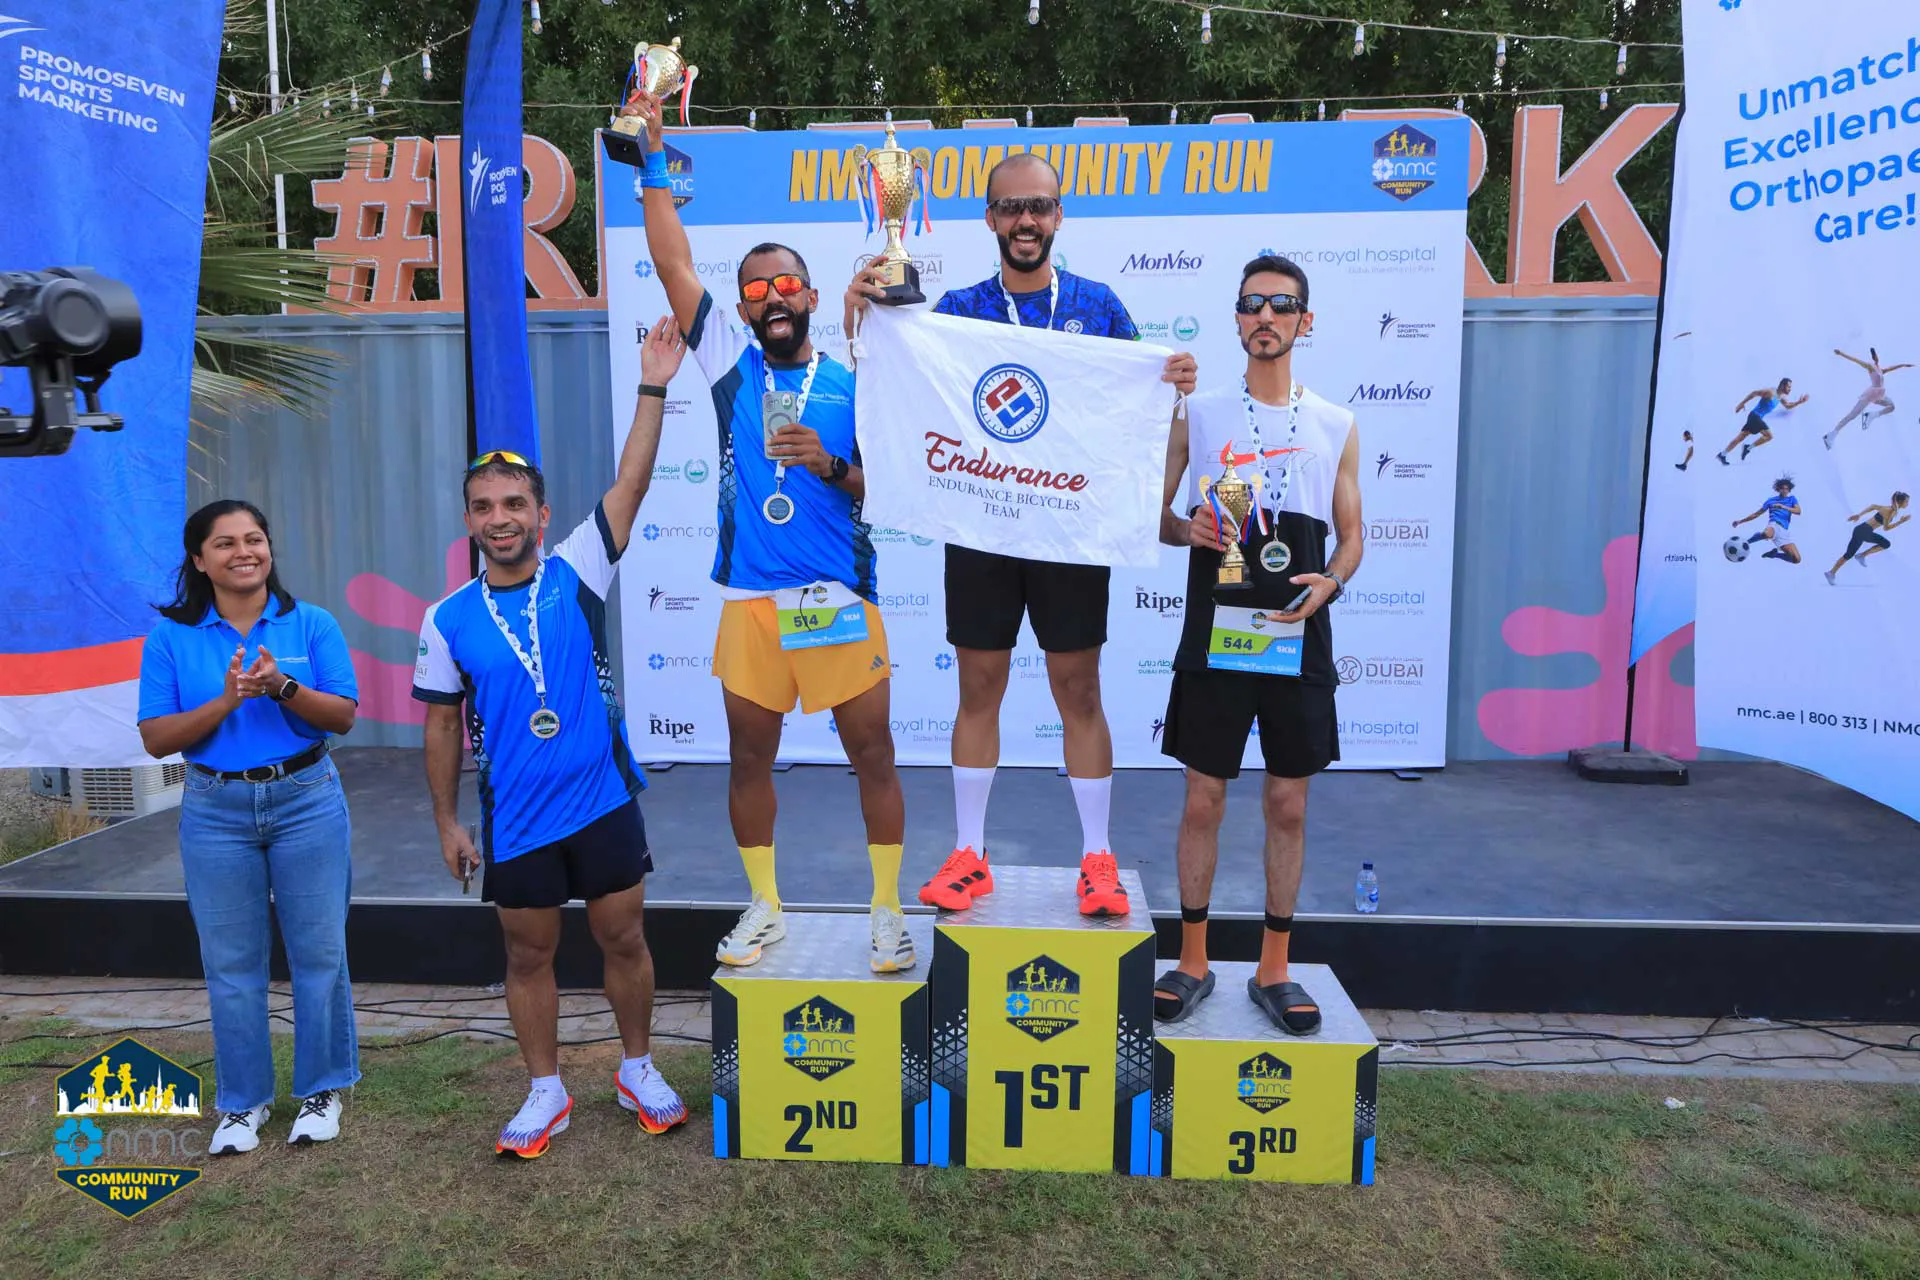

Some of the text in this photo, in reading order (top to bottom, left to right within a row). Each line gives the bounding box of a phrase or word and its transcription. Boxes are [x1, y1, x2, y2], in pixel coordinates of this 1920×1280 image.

[18, 64, 113, 103] SPORTS
[20, 45, 186, 108] PROMOSEVEN
[18, 83, 158, 134] MARKETING
[1183, 139, 1274, 195] RUN
[1394, 162, 1437, 176] nmc
[1381, 181, 1427, 189] COMMUNITY
[1395, 187, 1412, 195] RUN
[1815, 192, 1916, 243] Care!
[1318, 248, 1360, 267] royal
[1365, 246, 1436, 267] hospital
[925, 431, 1090, 492] Endurance
[928, 476, 1081, 512] ENDURANCE BICYCLES
[983, 501, 1021, 520] TEAM
[661, 526, 694, 538] nmc
[1370, 525, 1429, 540] DUBAI
[877, 593, 929, 609] ospital
[1135, 591, 1184, 613] Ripe
[1356, 590, 1425, 607] hospital
[793, 614, 819, 628] 514
[1223, 636, 1253, 651] 544
[665, 656, 699, 667] nmc
[1366, 663, 1424, 678] DUBAI
[1737, 707, 1795, 721] nmc.ae
[1808, 712, 1838, 727] 800
[1842, 715, 1868, 730] 313
[649, 718, 695, 739] Ripe
[1351, 720, 1419, 737] hospital
[1031, 997, 1080, 1015] nmc
[1016, 1018, 1069, 1030] COMMUNITY
[1032, 1026, 1053, 1035] RUN
[808, 1041, 856, 1053] nmc
[810, 1065, 829, 1073] RUN
[1256, 1083, 1292, 1094] nmc
[995, 1063, 1090, 1148] 1ST
[783, 1100, 857, 1153] 2ND
[1228, 1127, 1296, 1175] 3RD
